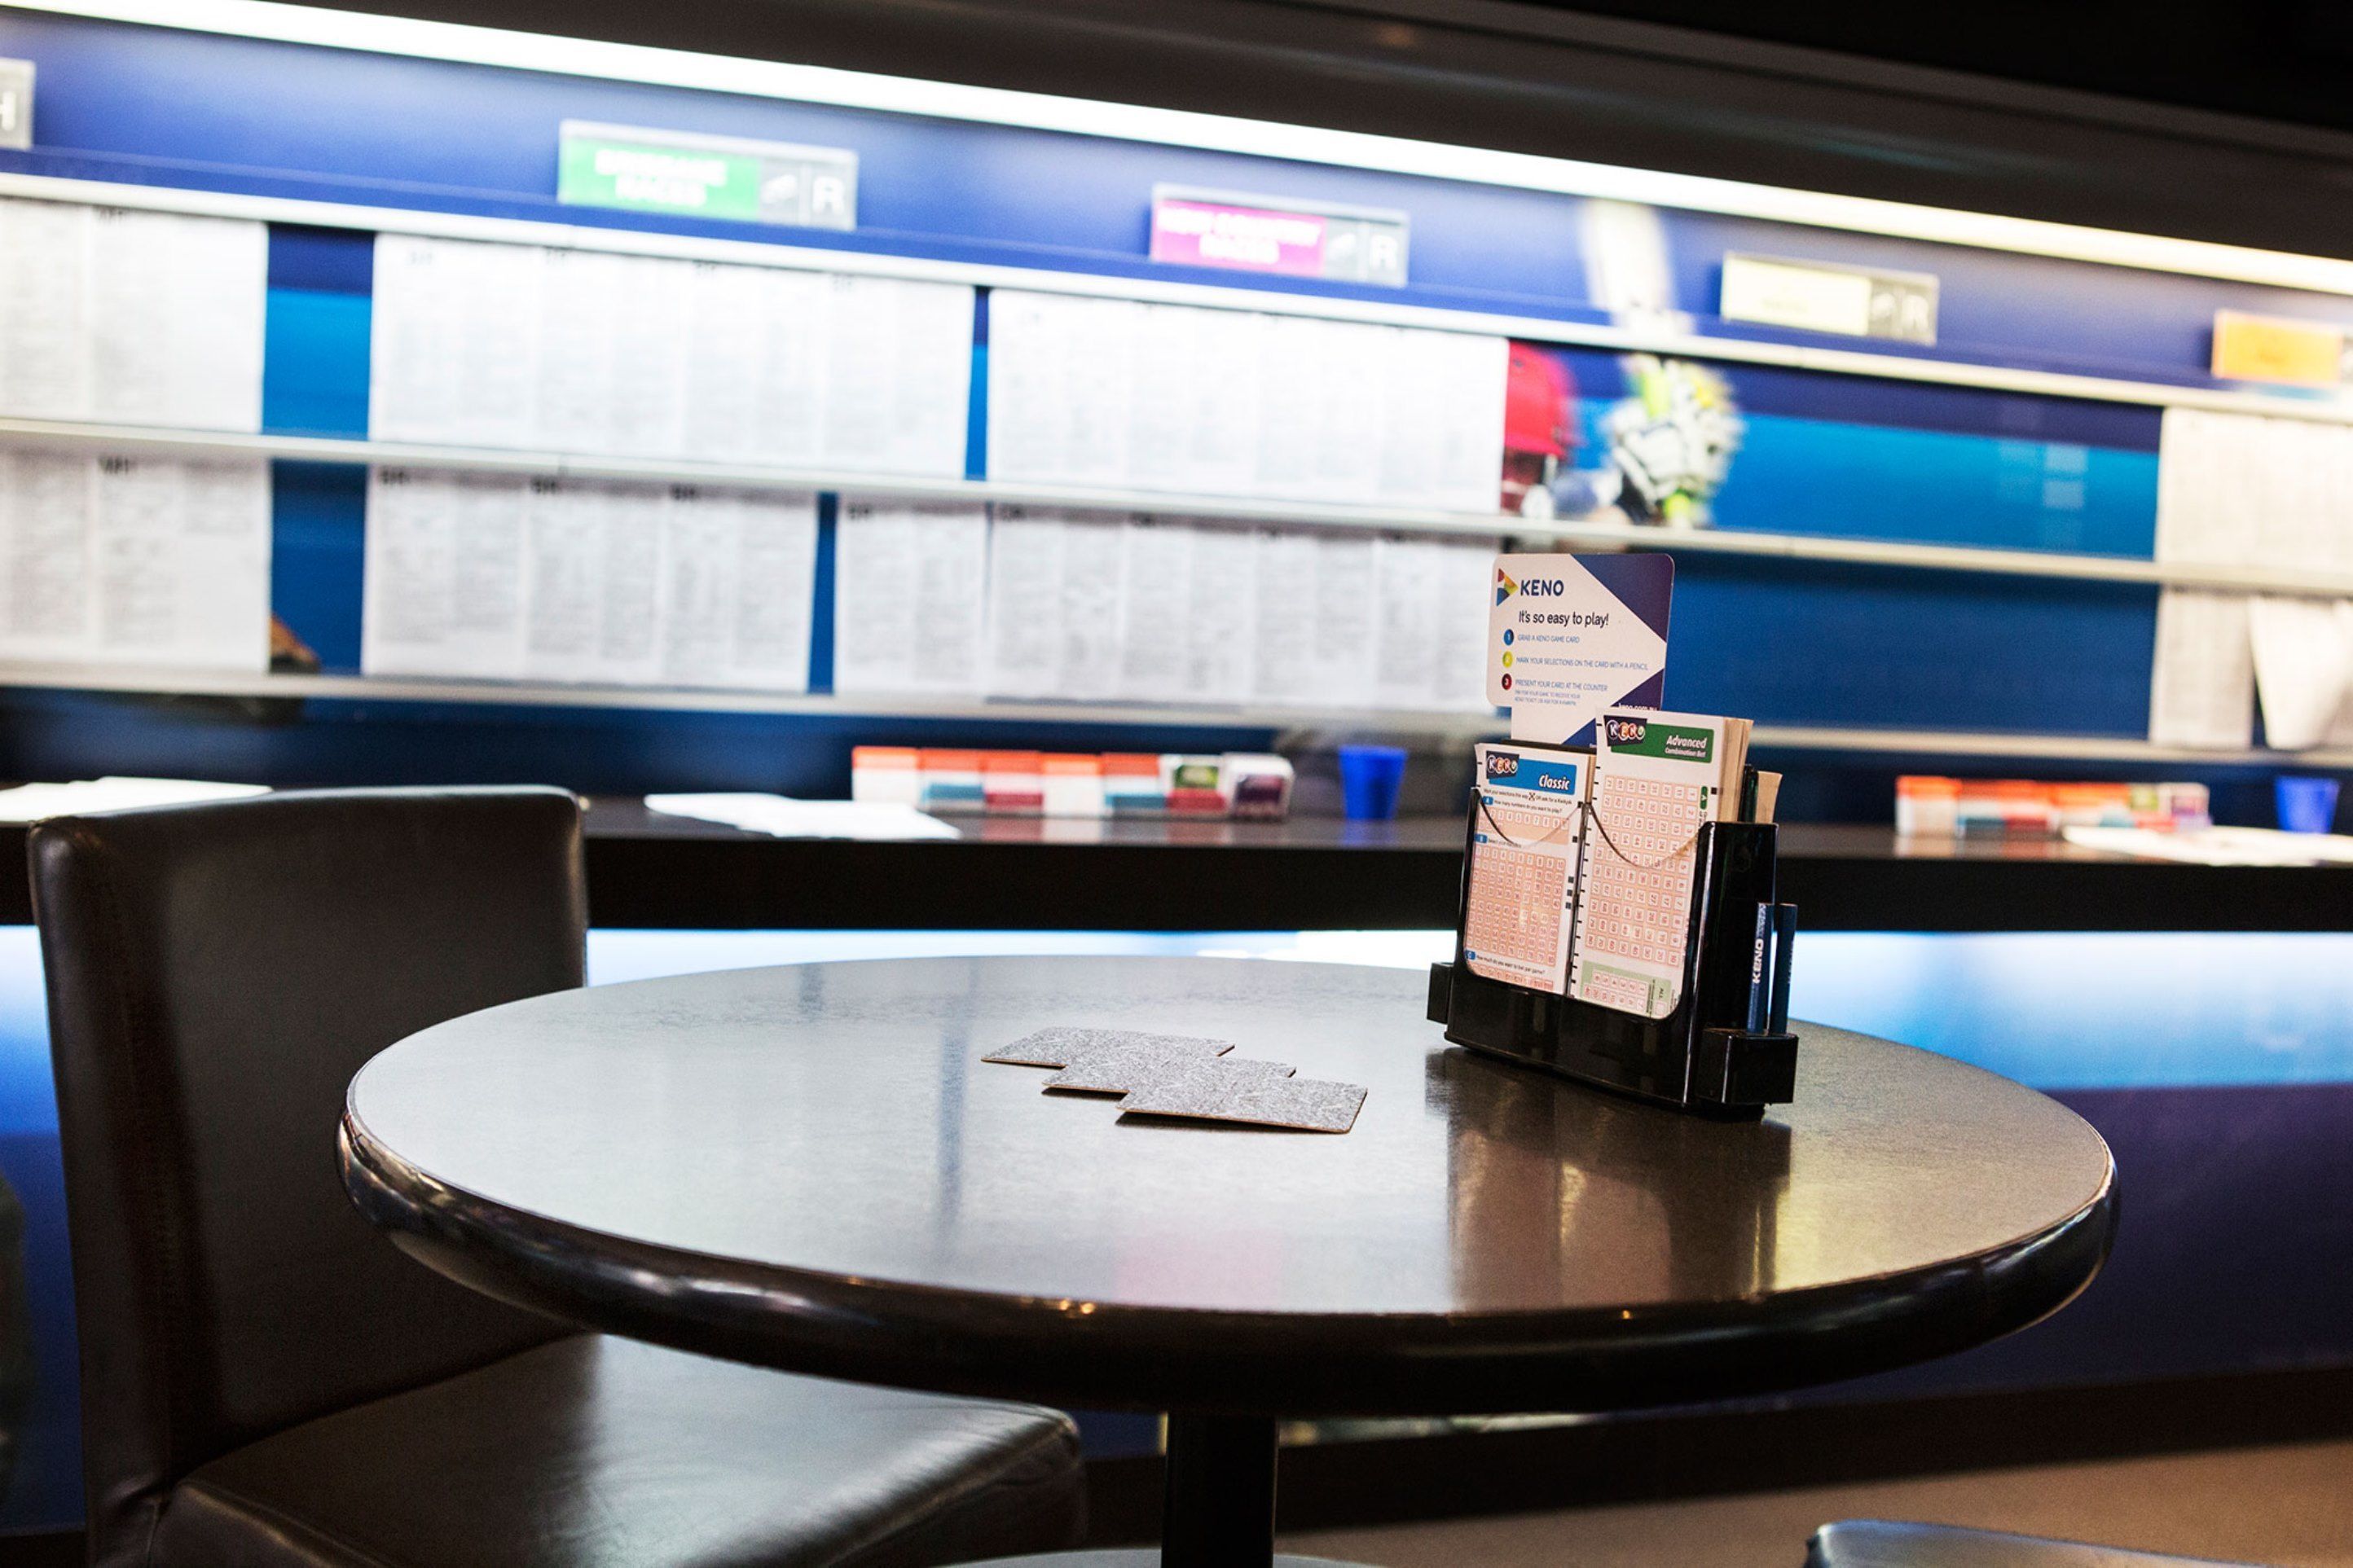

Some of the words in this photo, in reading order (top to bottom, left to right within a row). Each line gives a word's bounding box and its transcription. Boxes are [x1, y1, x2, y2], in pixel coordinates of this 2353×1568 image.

[1520, 579, 1564, 596] KENO
[1519, 610, 1531, 623] It's
[1533, 613, 1545, 623] so
[1546, 614, 1570, 627] easy
[1572, 611, 1582, 625] to
[1585, 612, 1609, 627] play!
[1544, 658, 1573, 666] SELECTIONS
[1607, 720, 1645, 740] KENO
[1666, 735, 1708, 749] Advanced
[1487, 755, 1518, 774] KENO
[1538, 774, 1570, 790] Classic
[1753, 938, 1764, 984] KENO
